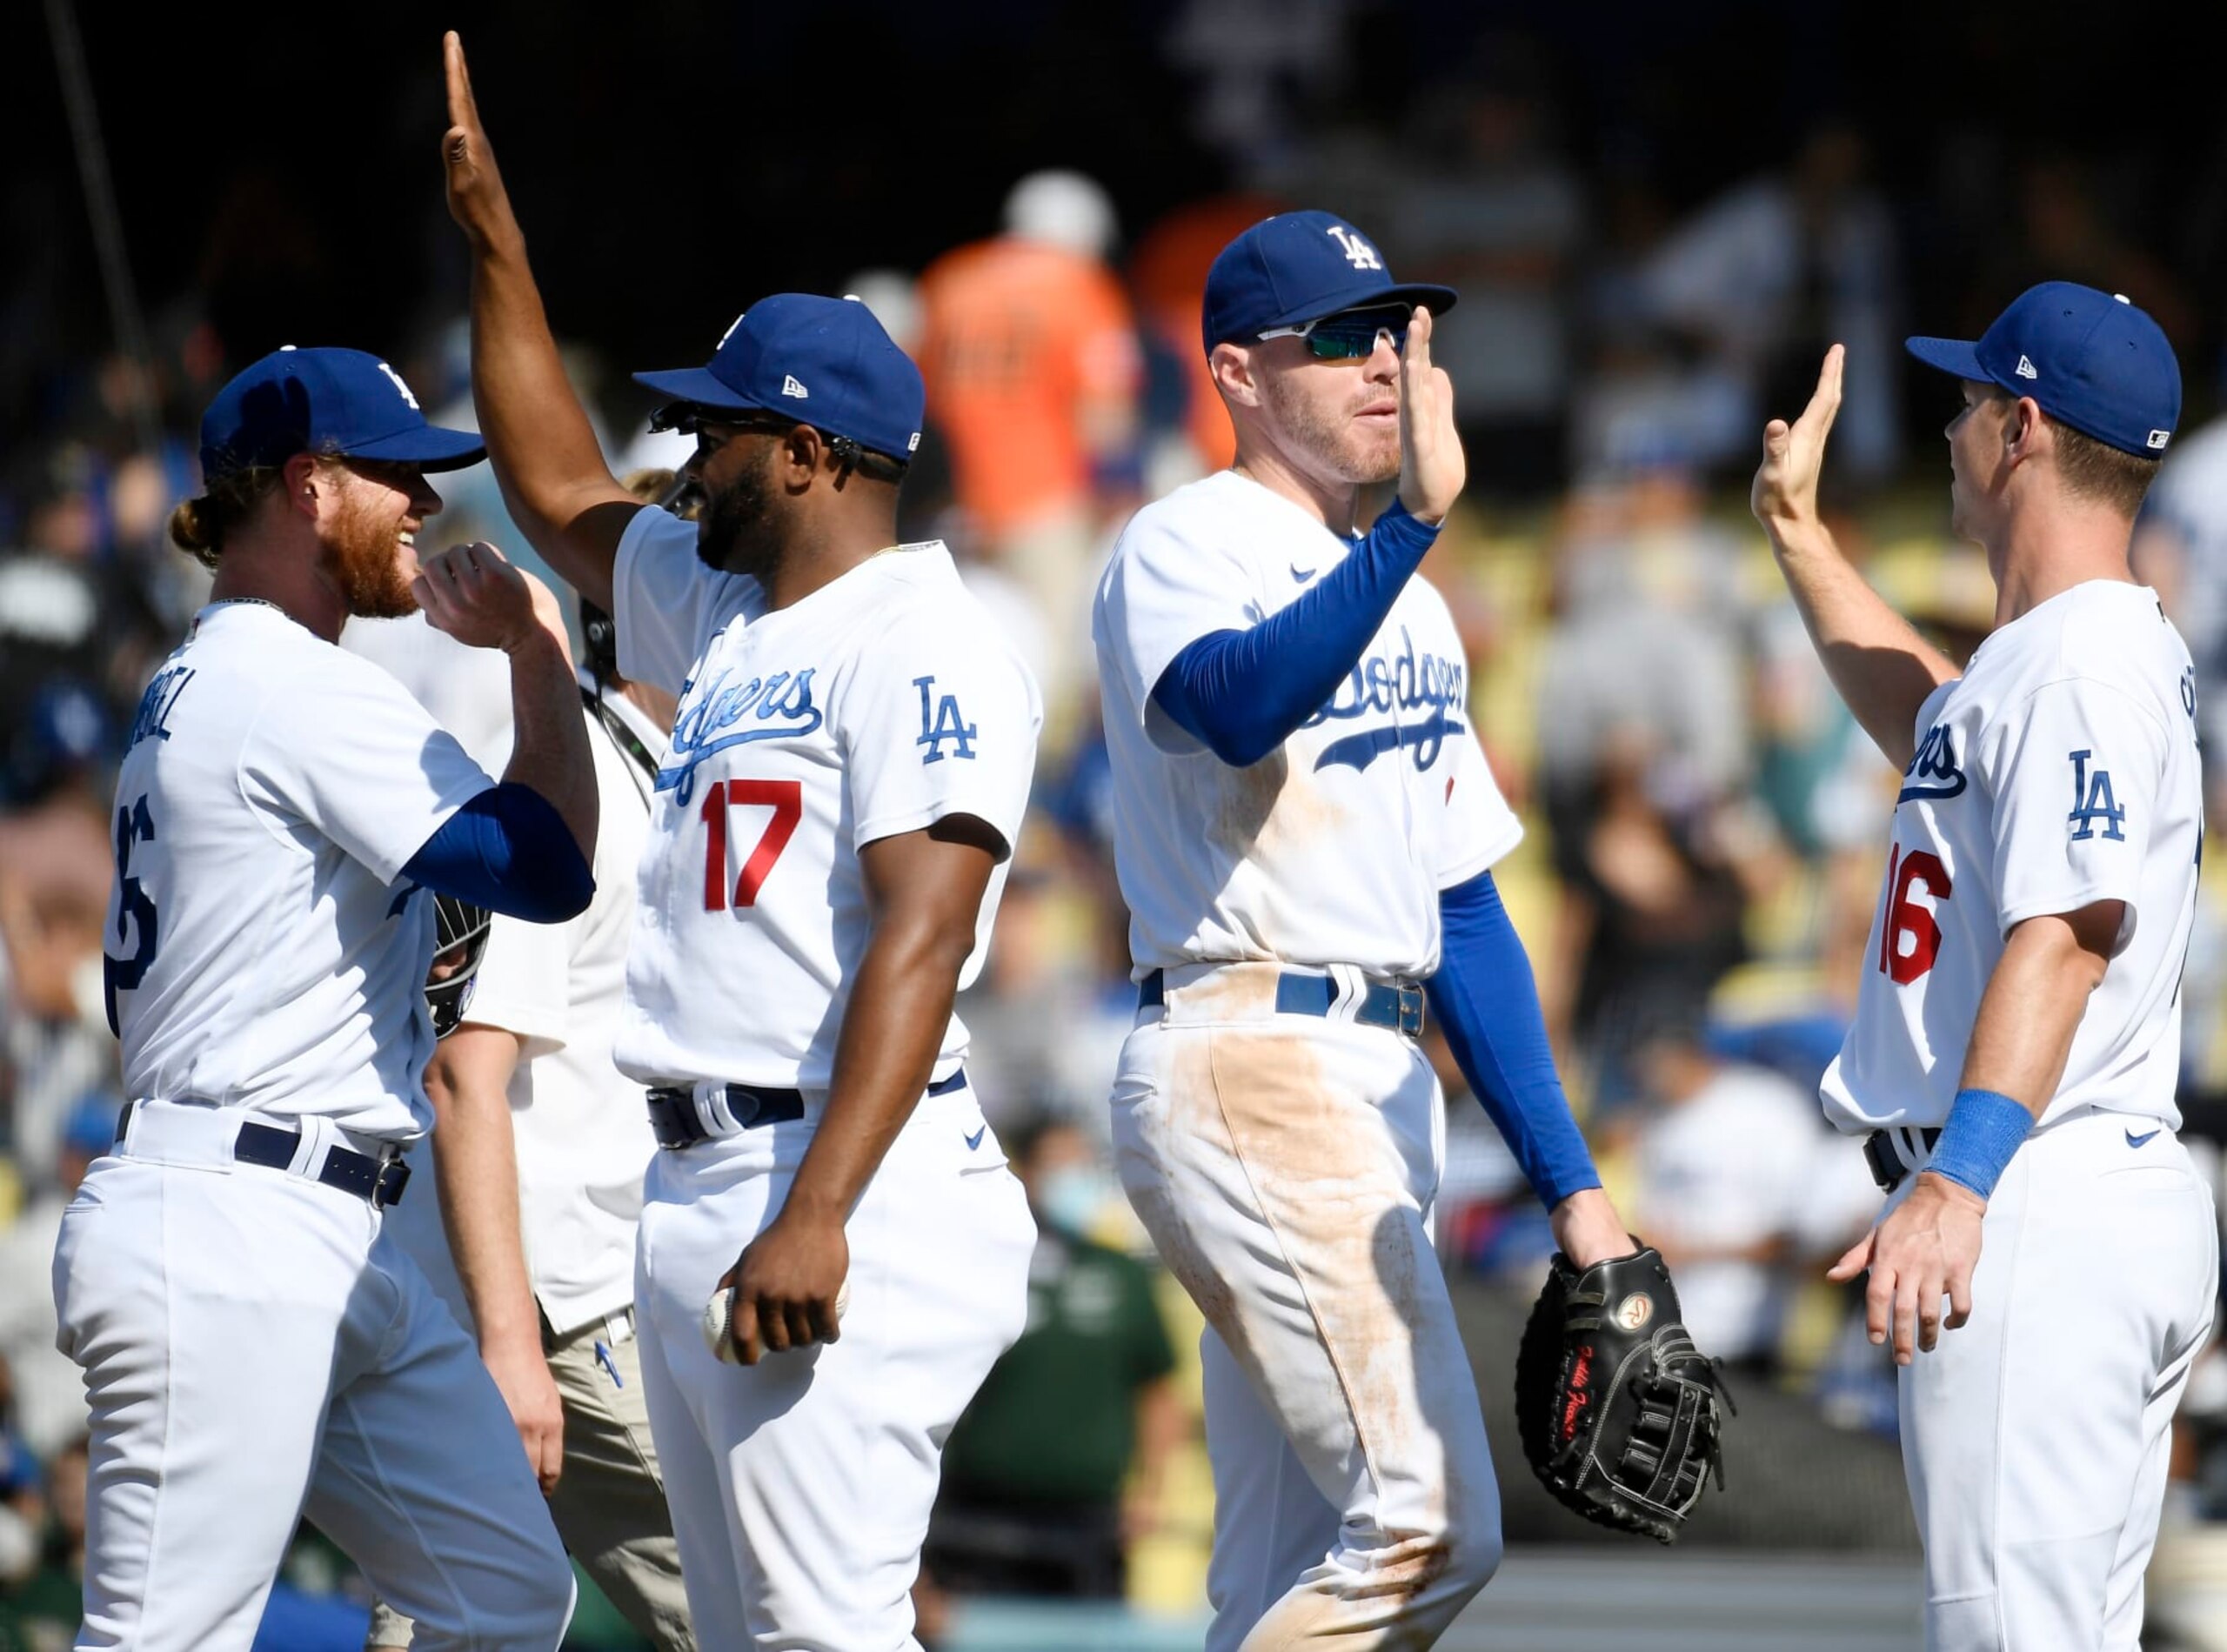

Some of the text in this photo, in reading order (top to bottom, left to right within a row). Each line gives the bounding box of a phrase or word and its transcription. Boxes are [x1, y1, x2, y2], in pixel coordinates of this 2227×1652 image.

[1326, 226, 1381, 271] LA
[913, 675, 978, 765] LA
[1299, 624, 1465, 773] Dodger
[701, 779, 802, 912] 17
[2068, 748, 2125, 842] LA
[1879, 841, 1953, 987] 16
